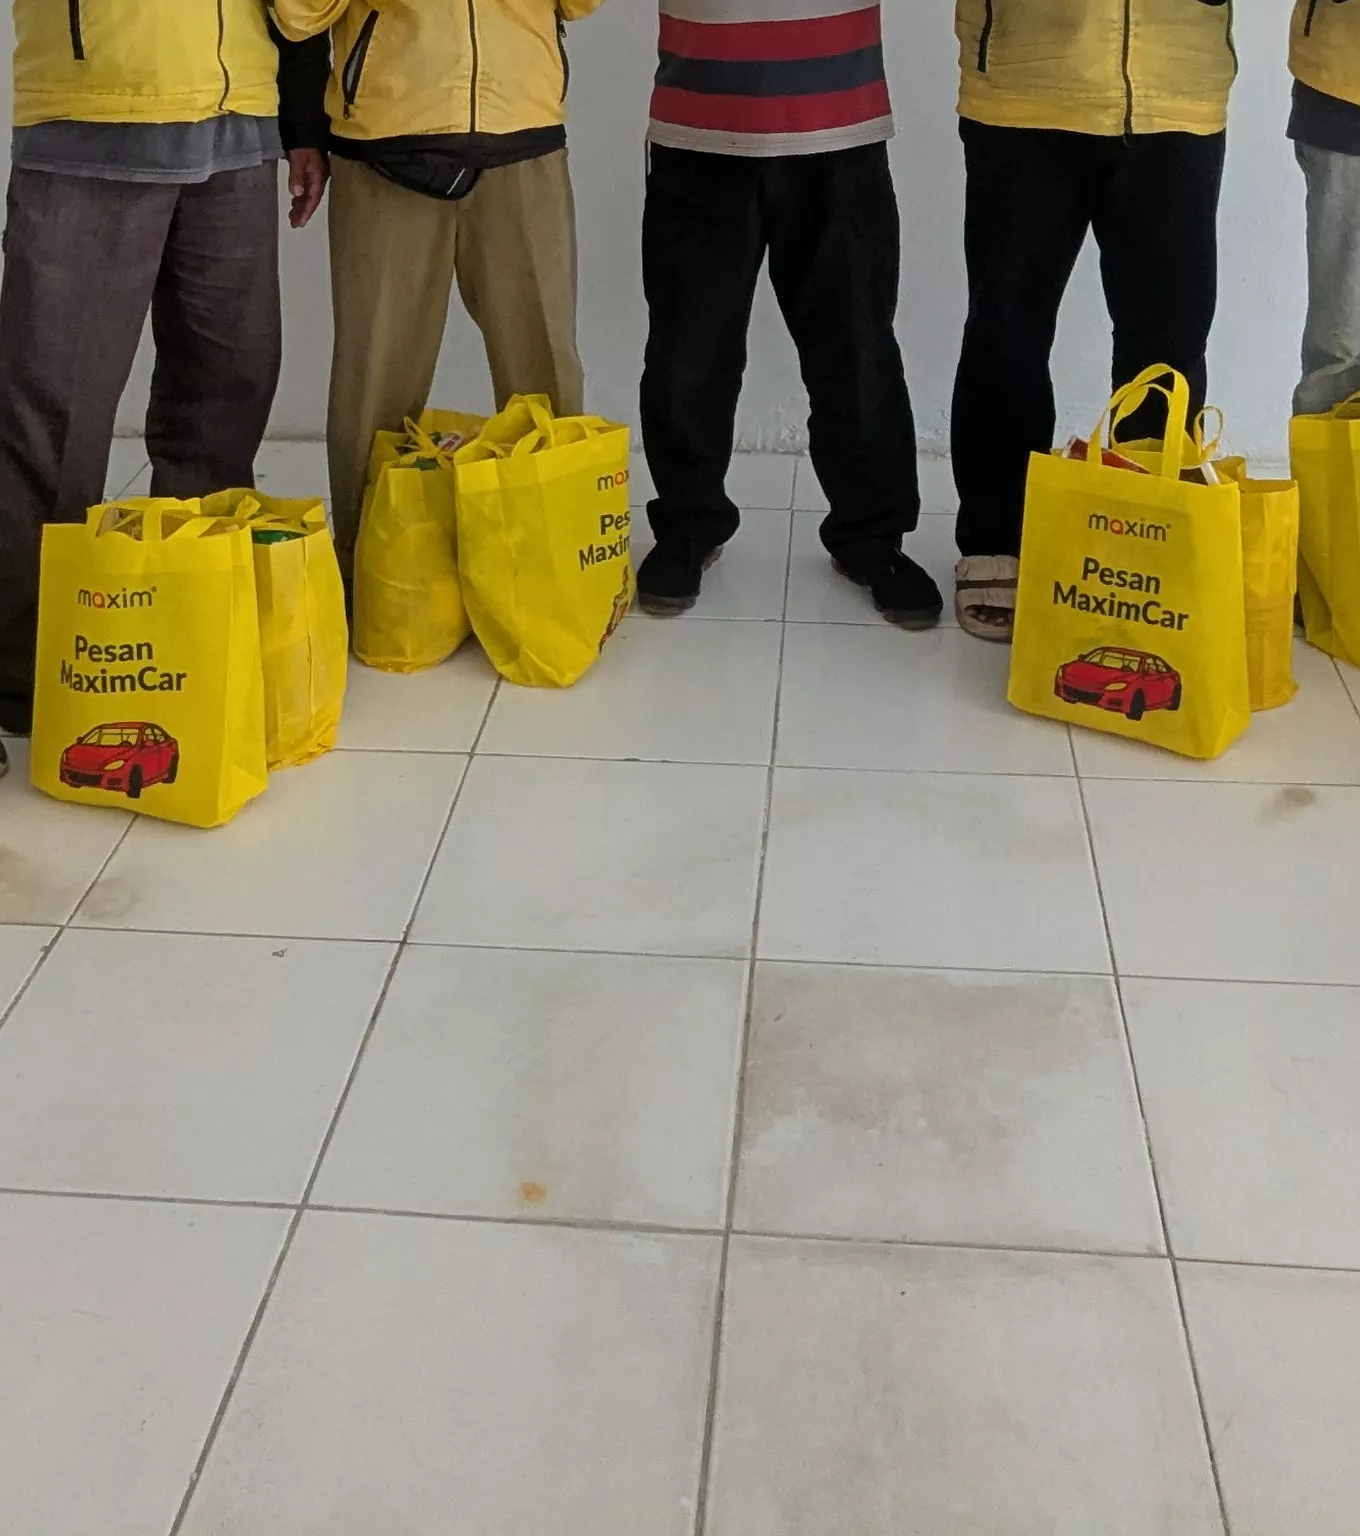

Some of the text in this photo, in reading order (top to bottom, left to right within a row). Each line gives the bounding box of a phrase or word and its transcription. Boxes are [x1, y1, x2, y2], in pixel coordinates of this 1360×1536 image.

[600, 511, 631, 536] Pes
[1088, 513, 1167, 542] maxim
[1081, 556, 1161, 595] Pesan
[78, 587, 153, 609] maxim
[1052, 580, 1189, 631] MaximCar
[75, 634, 154, 663] Pesan
[60, 659, 187, 694] MaximCar
